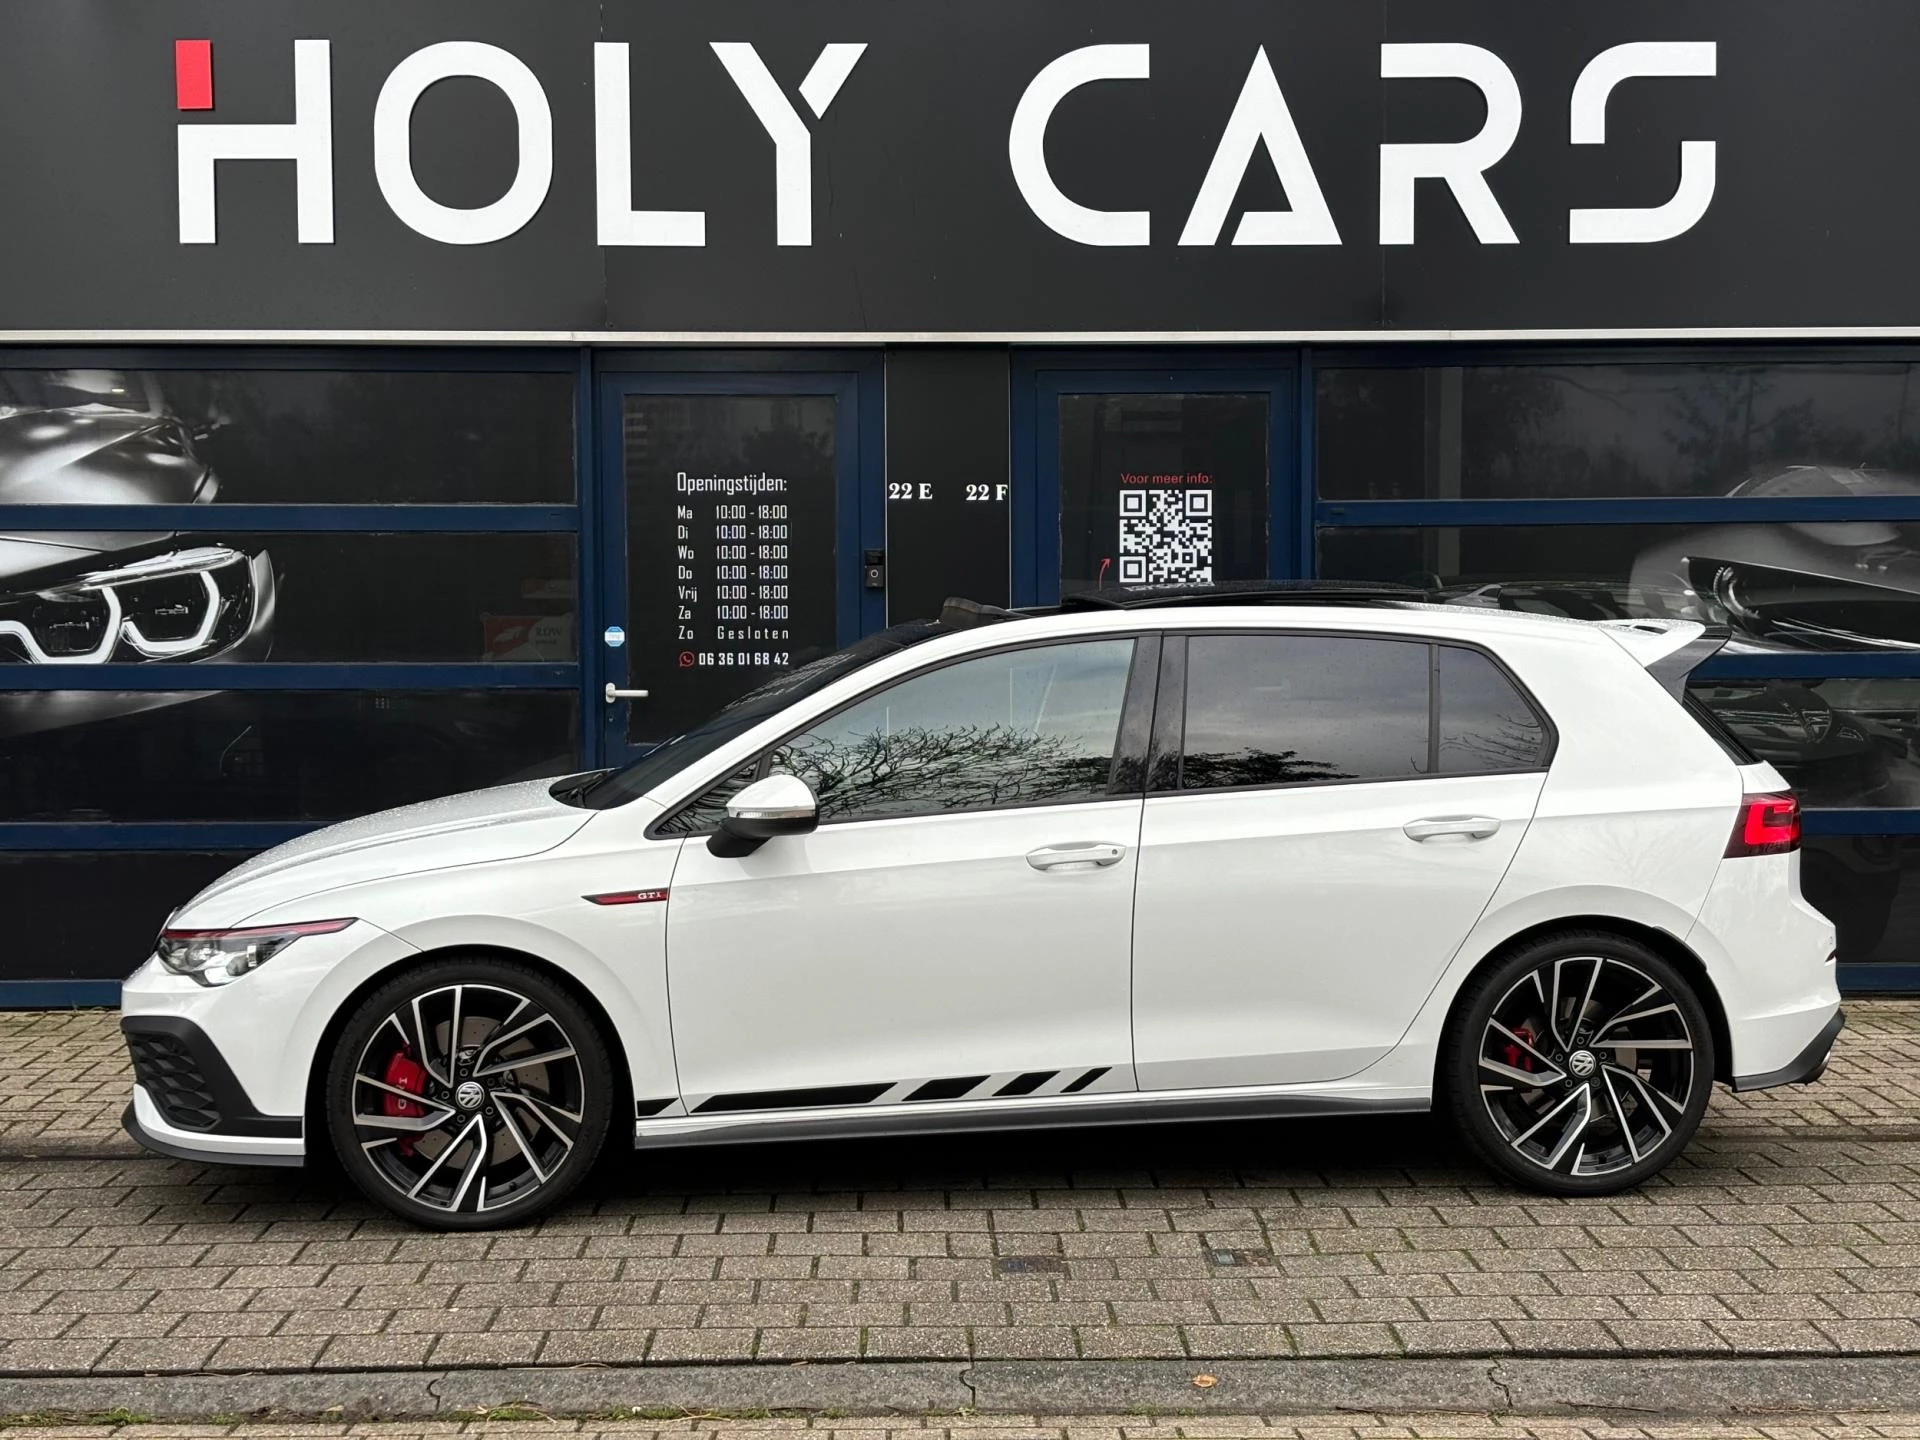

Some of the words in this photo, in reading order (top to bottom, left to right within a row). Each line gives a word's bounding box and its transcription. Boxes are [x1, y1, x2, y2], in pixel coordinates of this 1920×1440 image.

[176, 40, 869, 246] HOLY
[1009, 42, 1718, 246] CARS
[677, 472, 787, 495] Openingstijden:
[1120, 473, 1149, 484] Voor
[1152, 475, 1183, 484] meer
[1187, 473, 1213, 484] info:
[888, 482, 913, 499] 22
[918, 483, 933, 499] E
[966, 484, 990, 500] 22
[995, 484, 1008, 500] F
[677, 505, 693, 519] Ma
[716, 505, 746, 519] 10:00
[758, 505, 788, 519] 18:00
[678, 525, 689, 539] Di
[716, 525, 746, 539] 10:00
[758, 525, 788, 539] 18:00
[678, 545, 694, 559] Wo
[716, 545, 746, 559] 10:00
[758, 545, 788, 559] 18:00
[678, 566, 693, 580] Do
[716, 566, 746, 580] 10:00
[758, 566, 788, 580] 18:00
[678, 586, 698, 603] Vrij
[716, 586, 746, 600] 10:00
[758, 586, 788, 600] 18:00
[678, 606, 691, 620] Za
[716, 606, 746, 620] 10:00
[758, 606, 788, 620] 18:00
[678, 626, 694, 640] Zo
[717, 626, 789, 640] Gesloten
[698, 652, 714, 666] 06
[718, 652, 733, 666] 36
[738, 652, 750, 666] 01
[754, 652, 769, 666] 68
[773, 652, 789, 666] 42
[638, 892, 662, 900] GTI
